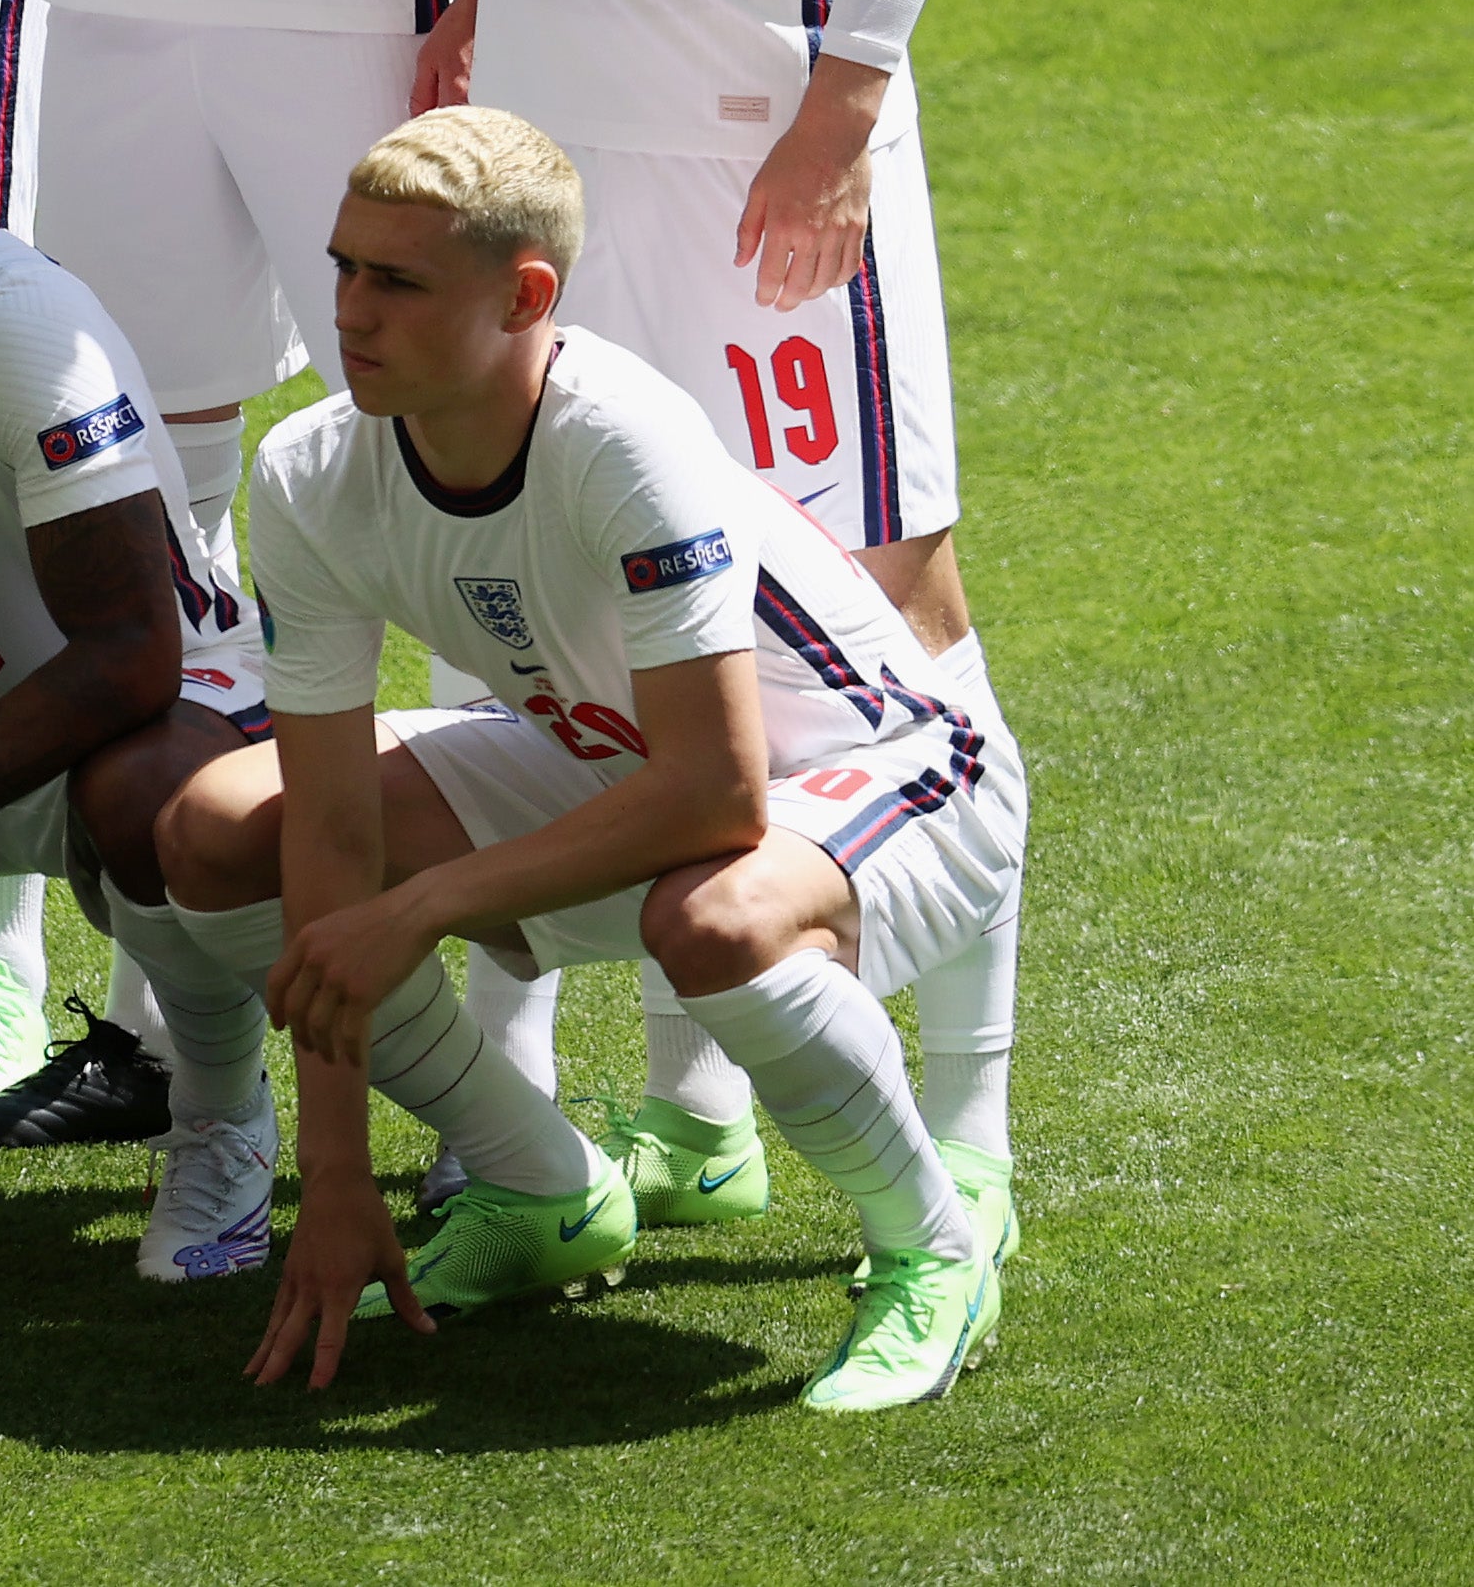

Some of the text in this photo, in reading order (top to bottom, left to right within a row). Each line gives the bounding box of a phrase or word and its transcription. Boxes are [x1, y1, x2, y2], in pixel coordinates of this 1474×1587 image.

[76, 403, 137, 447] RESPECT
[725, 335, 840, 470] 19
[658, 536, 730, 577] RESPECT
[523, 694, 650, 761] 20
